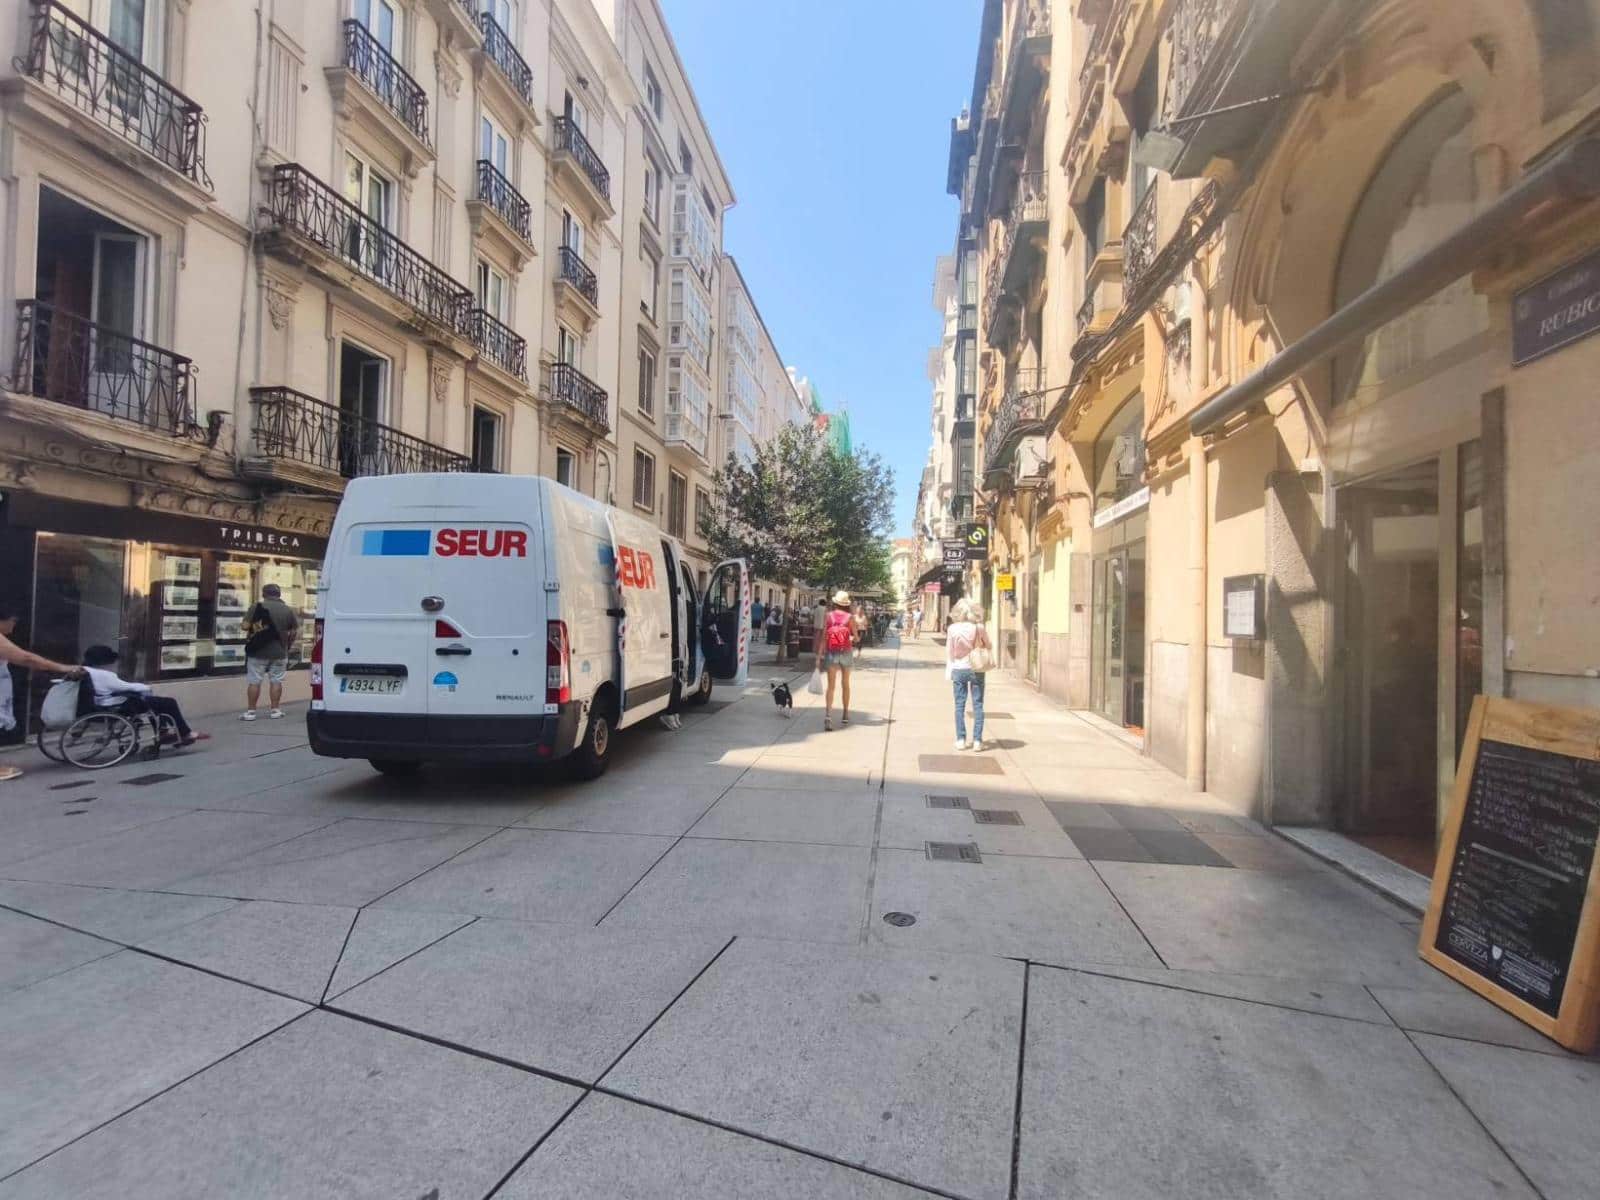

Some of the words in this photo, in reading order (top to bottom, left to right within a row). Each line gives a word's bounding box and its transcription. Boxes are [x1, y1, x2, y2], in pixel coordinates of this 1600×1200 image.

[220, 527, 300, 548] TRIBECA
[434, 527, 527, 557] SEUR
[616, 544, 656, 590] EUR
[347, 679, 374, 692] 4934
[377, 680, 401, 693] LYF
[495, 694, 535, 702] RENAULT
